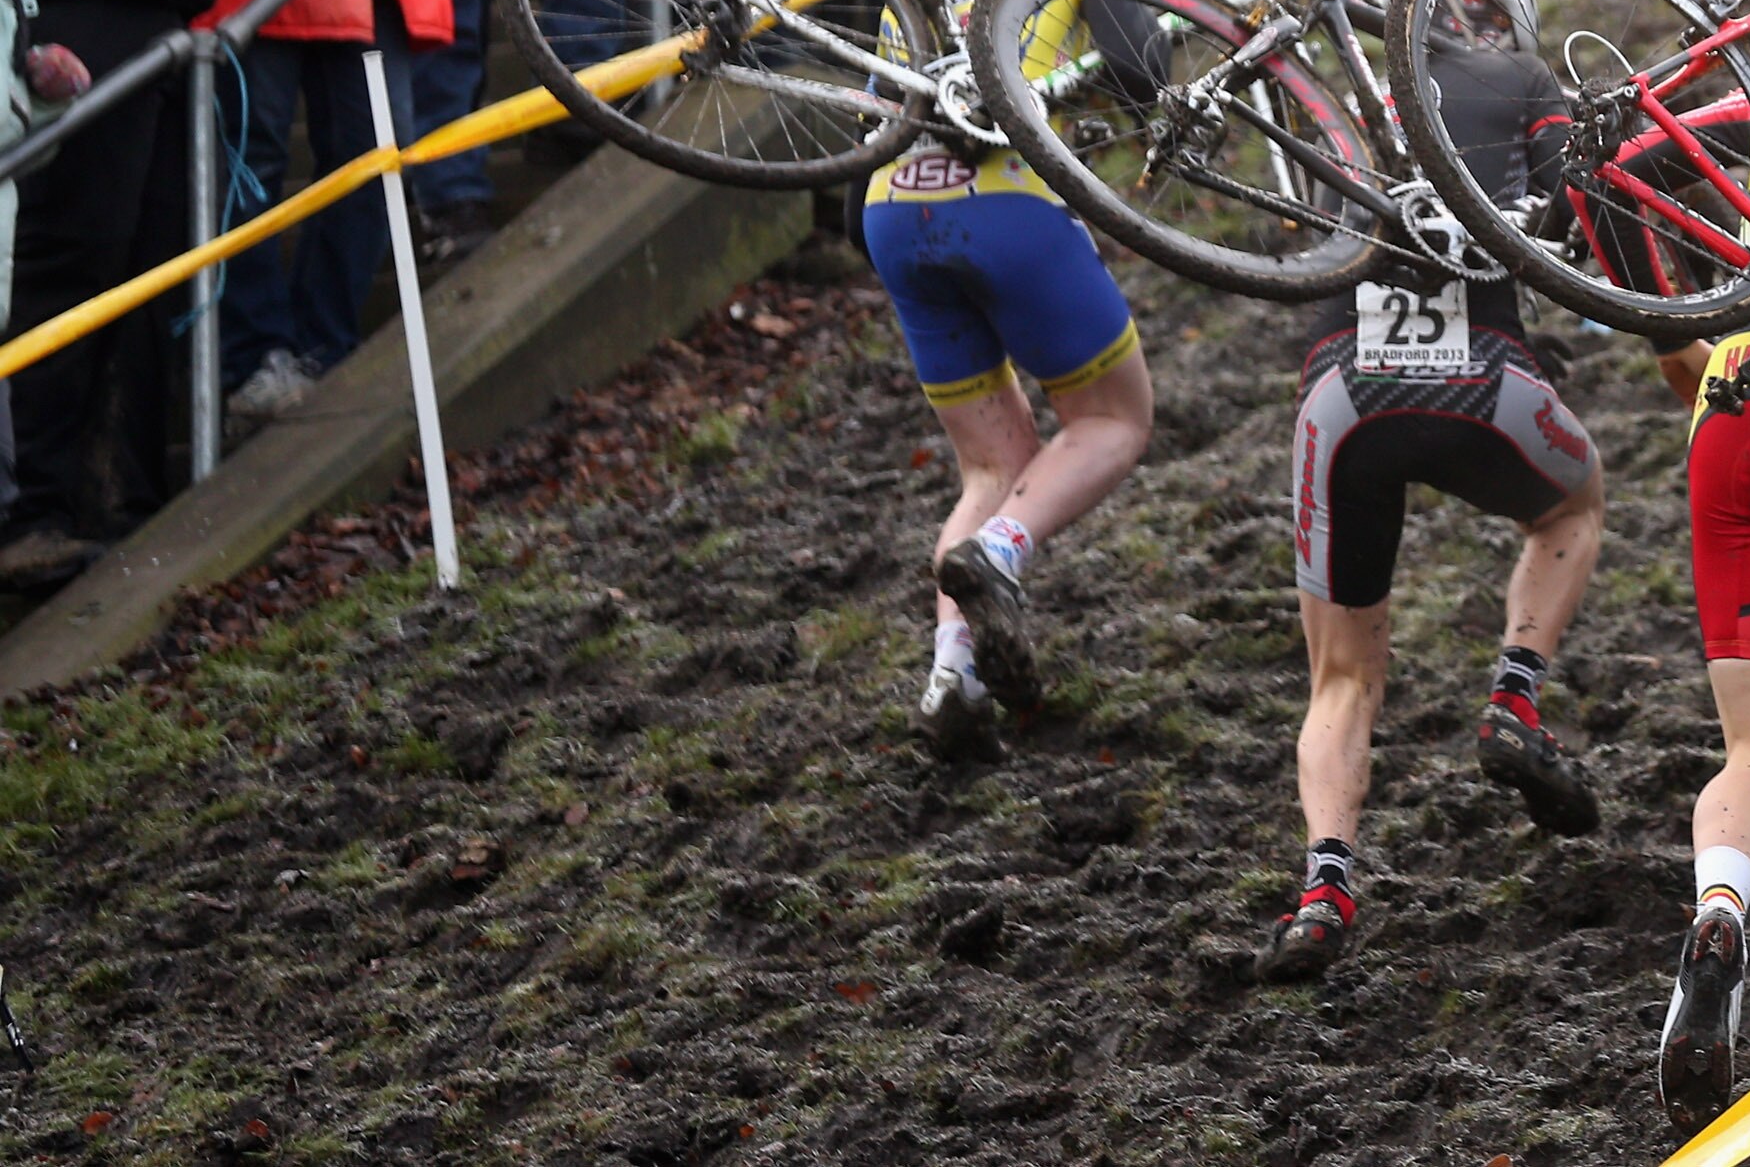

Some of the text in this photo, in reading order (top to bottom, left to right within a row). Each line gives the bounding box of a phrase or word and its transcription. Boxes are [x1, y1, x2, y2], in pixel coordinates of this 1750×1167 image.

[1382, 293, 1446, 345] 25
[1364, 348, 1465, 361] BRADFORD 2013
